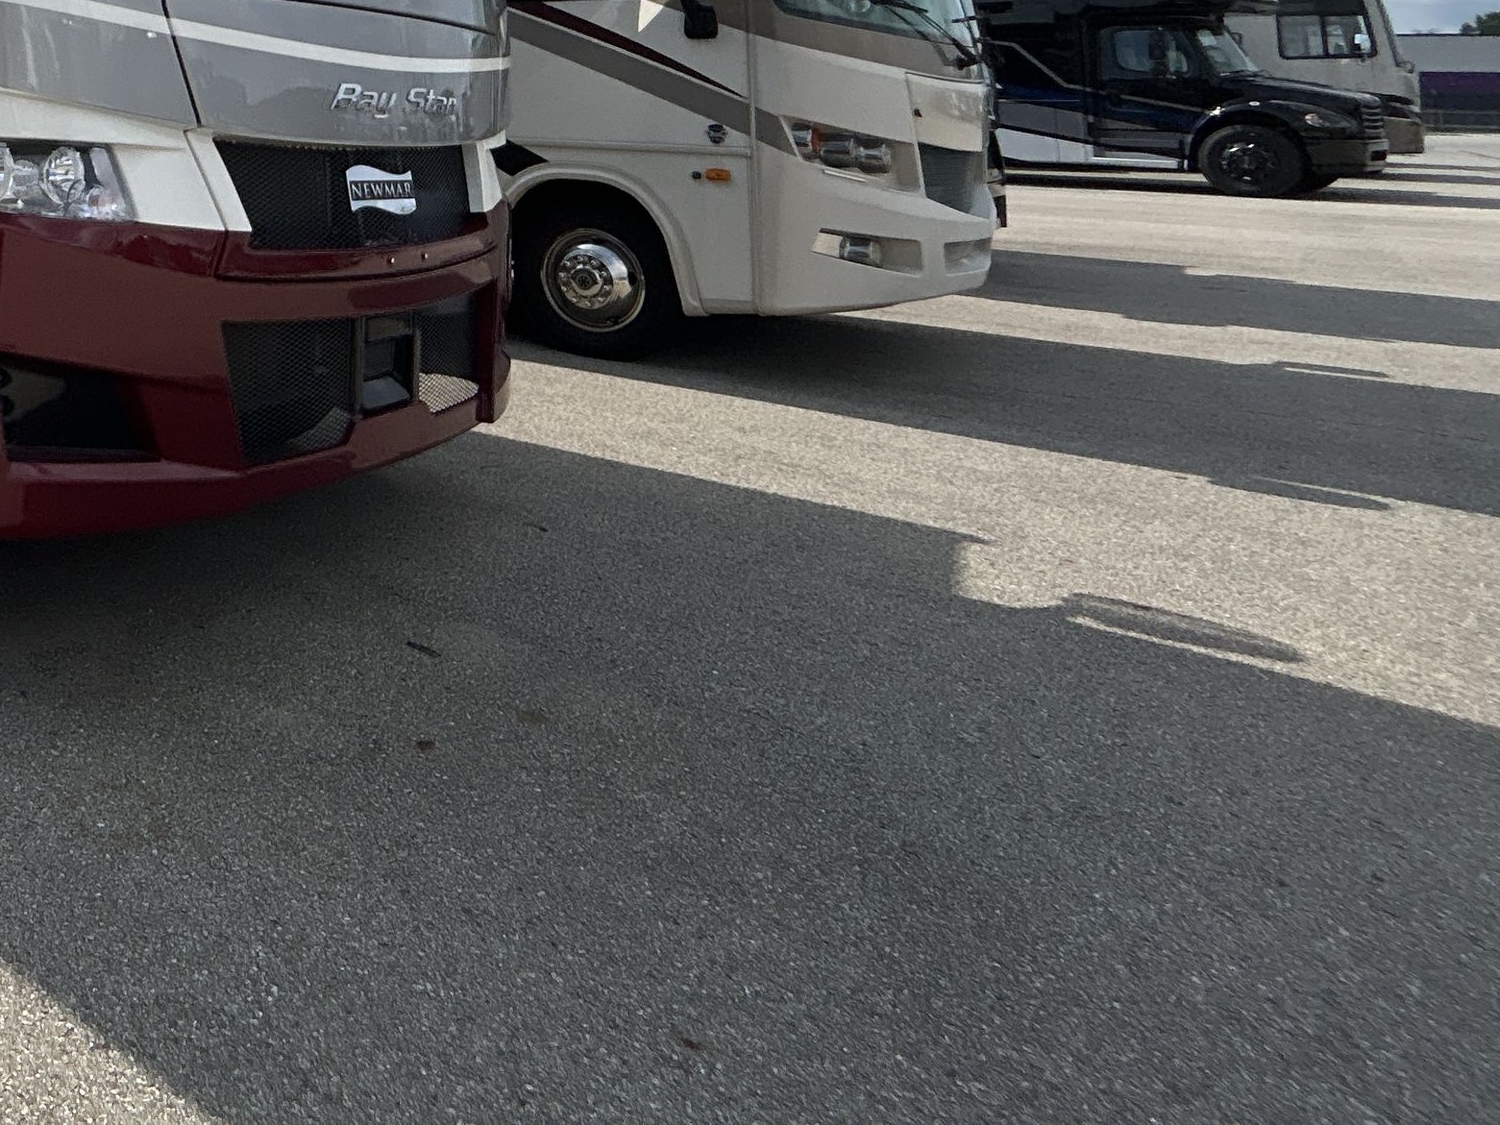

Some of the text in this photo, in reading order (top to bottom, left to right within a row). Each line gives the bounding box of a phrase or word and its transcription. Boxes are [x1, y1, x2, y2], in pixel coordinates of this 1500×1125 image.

[330, 82, 457, 119] Bay Star
[350, 182, 414, 199] NEWMAR
